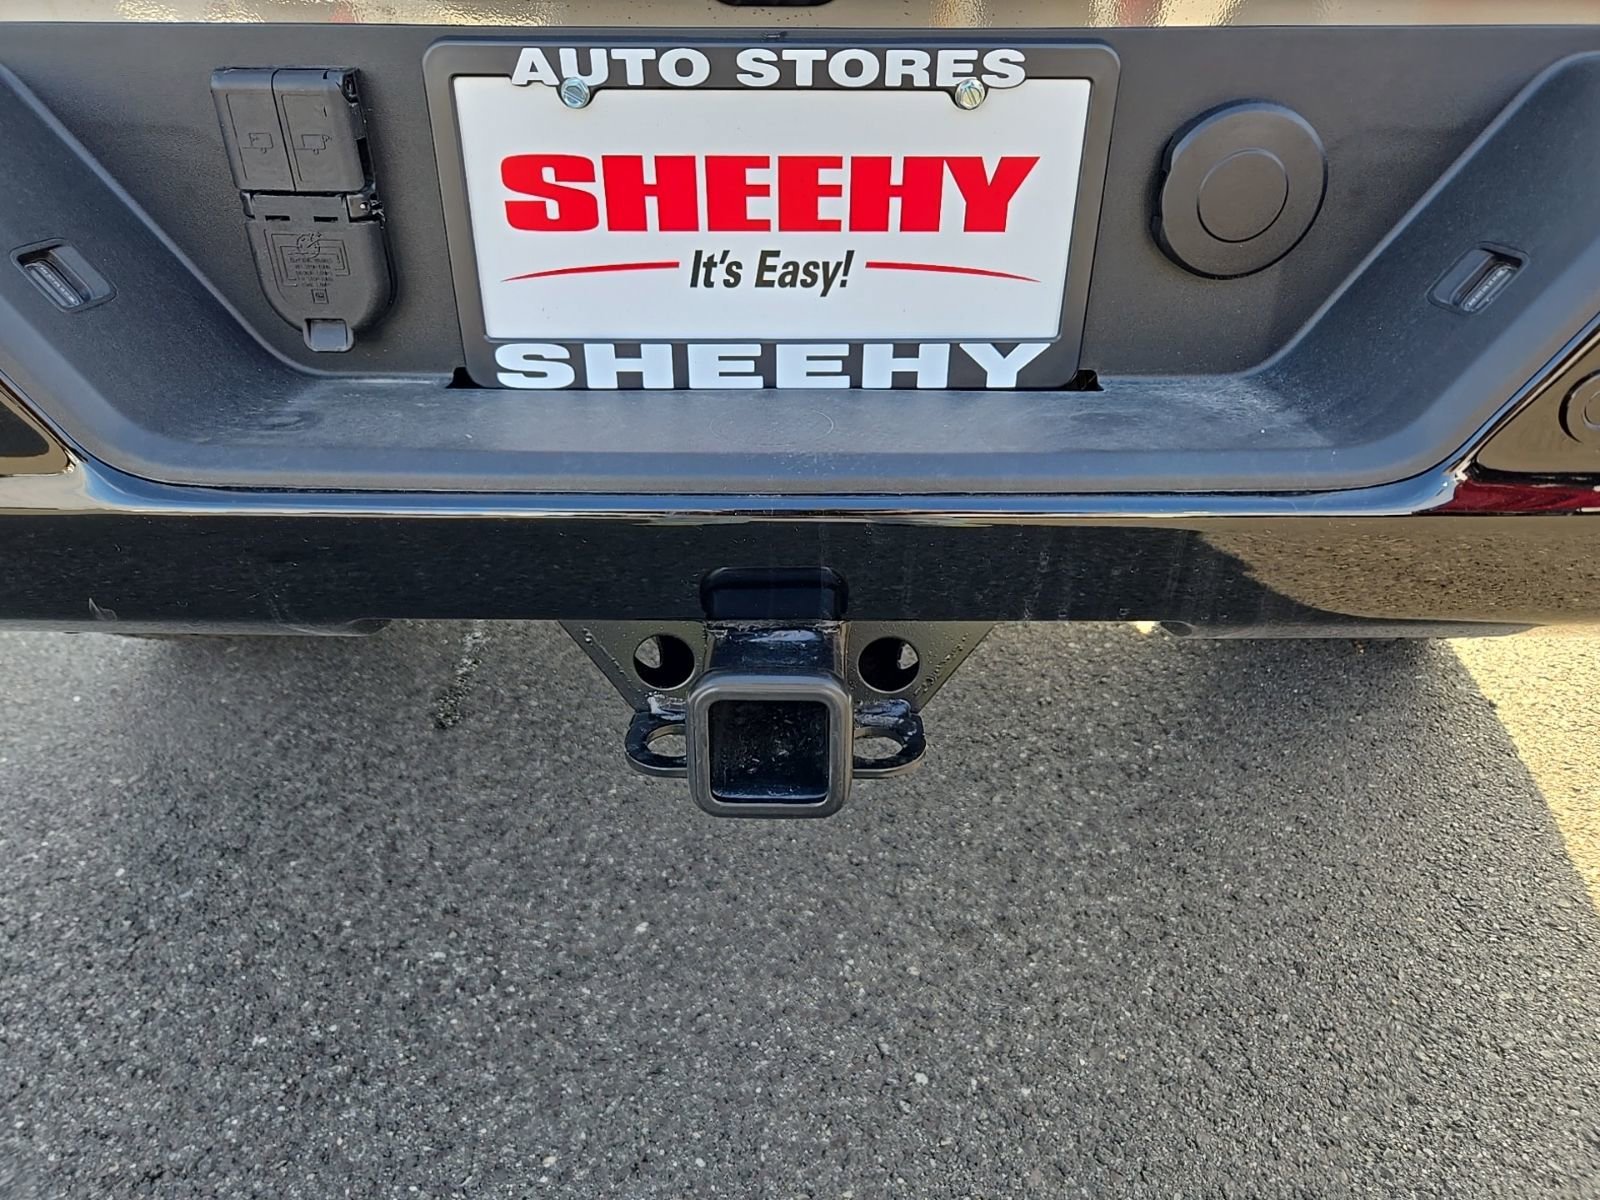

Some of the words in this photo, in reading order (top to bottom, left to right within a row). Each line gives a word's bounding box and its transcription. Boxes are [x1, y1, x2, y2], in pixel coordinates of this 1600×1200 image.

[511, 48, 711, 87] AUTO
[736, 48, 1026, 88] STORES
[500, 154, 1041, 233] SHEEHY
[689, 250, 743, 288] It's
[754, 250, 855, 297] Easy!
[494, 343, 1052, 390] SHEEHY
